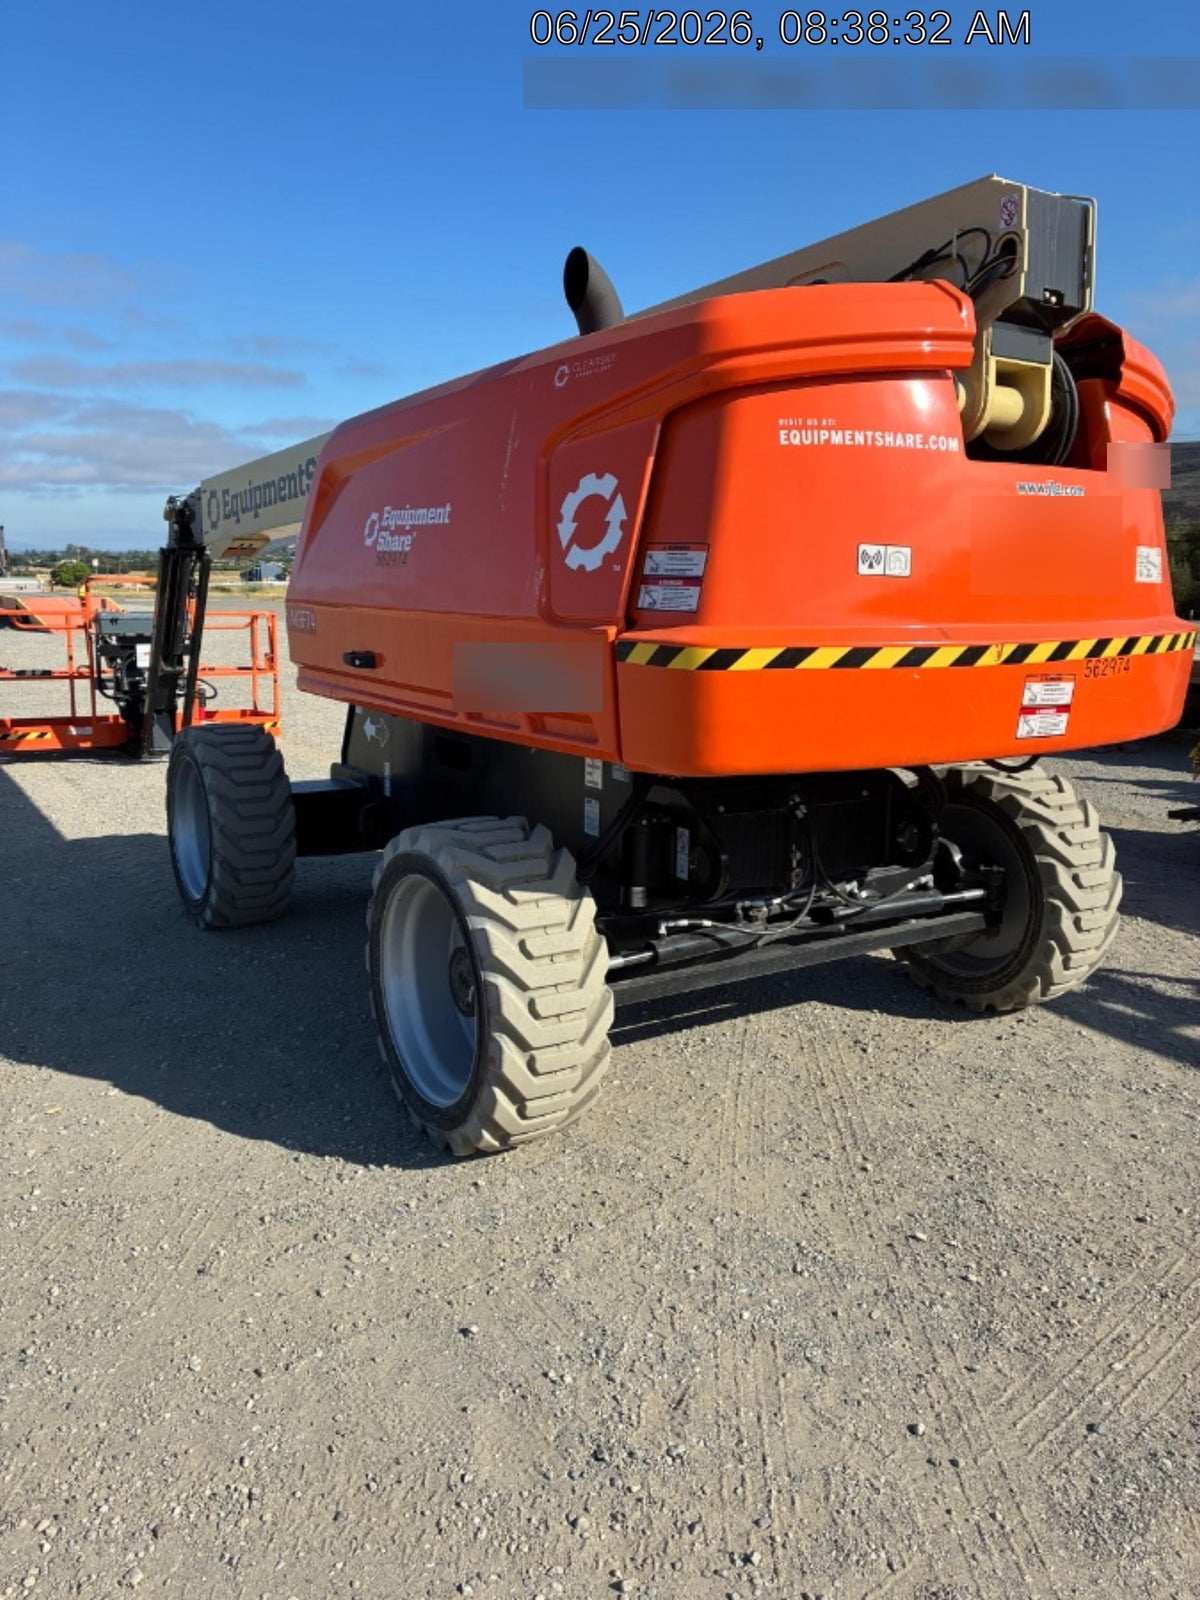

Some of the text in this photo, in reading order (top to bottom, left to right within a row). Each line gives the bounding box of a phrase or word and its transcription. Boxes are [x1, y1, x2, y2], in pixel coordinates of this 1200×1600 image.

[778, 417, 803, 426] VISIT
[806, 418, 818, 426] US
[779, 429, 959, 452] EQUIPMENTSHARE.COM
[1016, 480, 1086, 497] www.jlg.com
[381, 502, 452, 530] Equipment
[376, 531, 412, 551] Share
[1084, 656, 1131, 678] 562974
